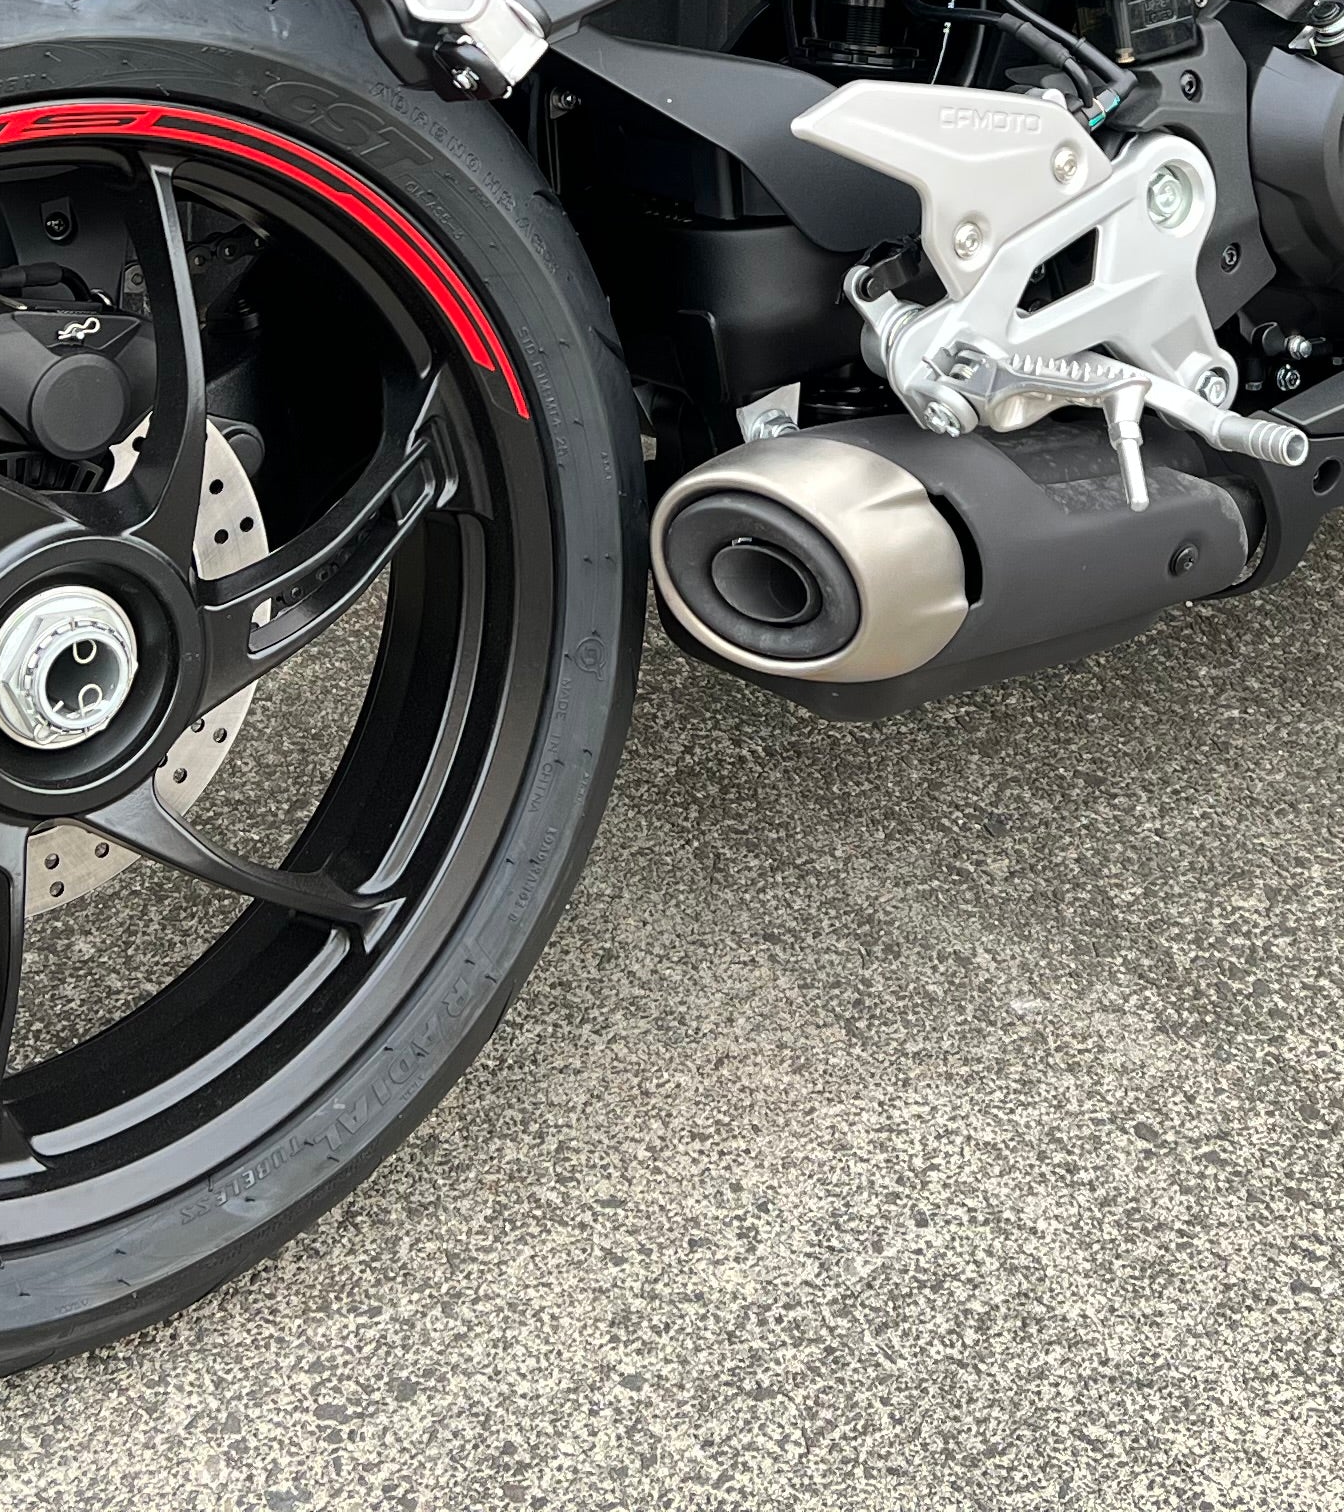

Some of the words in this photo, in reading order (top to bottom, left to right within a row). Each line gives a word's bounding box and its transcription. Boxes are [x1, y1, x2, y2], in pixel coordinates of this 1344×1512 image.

[257, 62, 435, 194] CST
[939, 107, 1042, 136] CFMOTO
[553, 678, 574, 721] MADE
[526, 760, 556, 816] CHINA
[176, 1132, 306, 1228] TUBELESS
